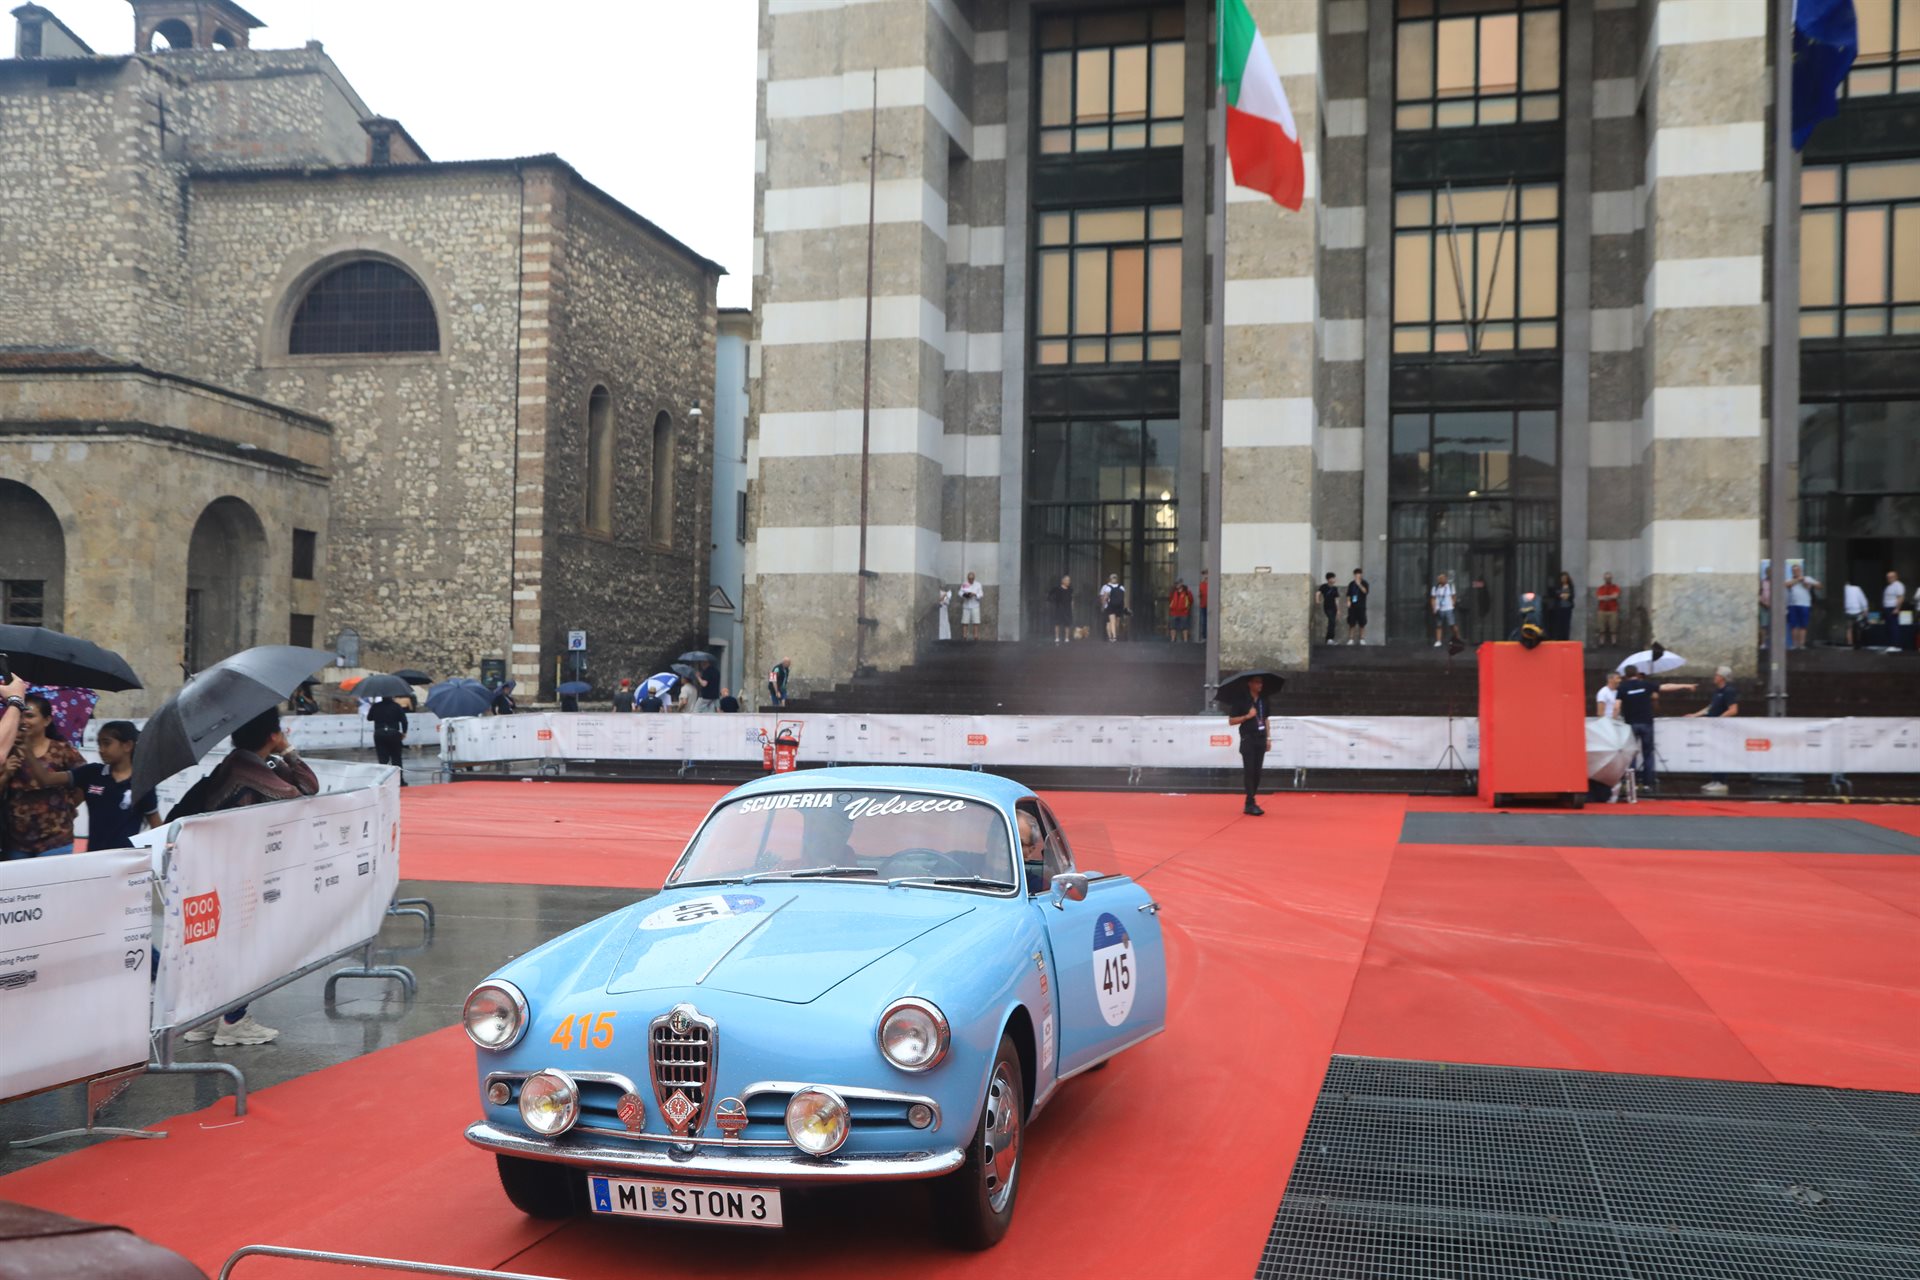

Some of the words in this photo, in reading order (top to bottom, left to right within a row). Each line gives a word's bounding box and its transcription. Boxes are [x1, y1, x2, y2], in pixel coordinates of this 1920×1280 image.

[739, 793, 833, 814] SCUDERIA
[843, 794, 967, 820] Velsecco
[17, 893, 41, 901] Partner
[185, 897, 214, 918] 1000
[673, 902, 719, 922] 415
[16, 953, 40, 962] Partner
[1103, 953, 1130, 995] 415
[550, 1011, 617, 1050] 415
[600, 1199, 607, 1207] A
[617, 1184, 648, 1211] MI
